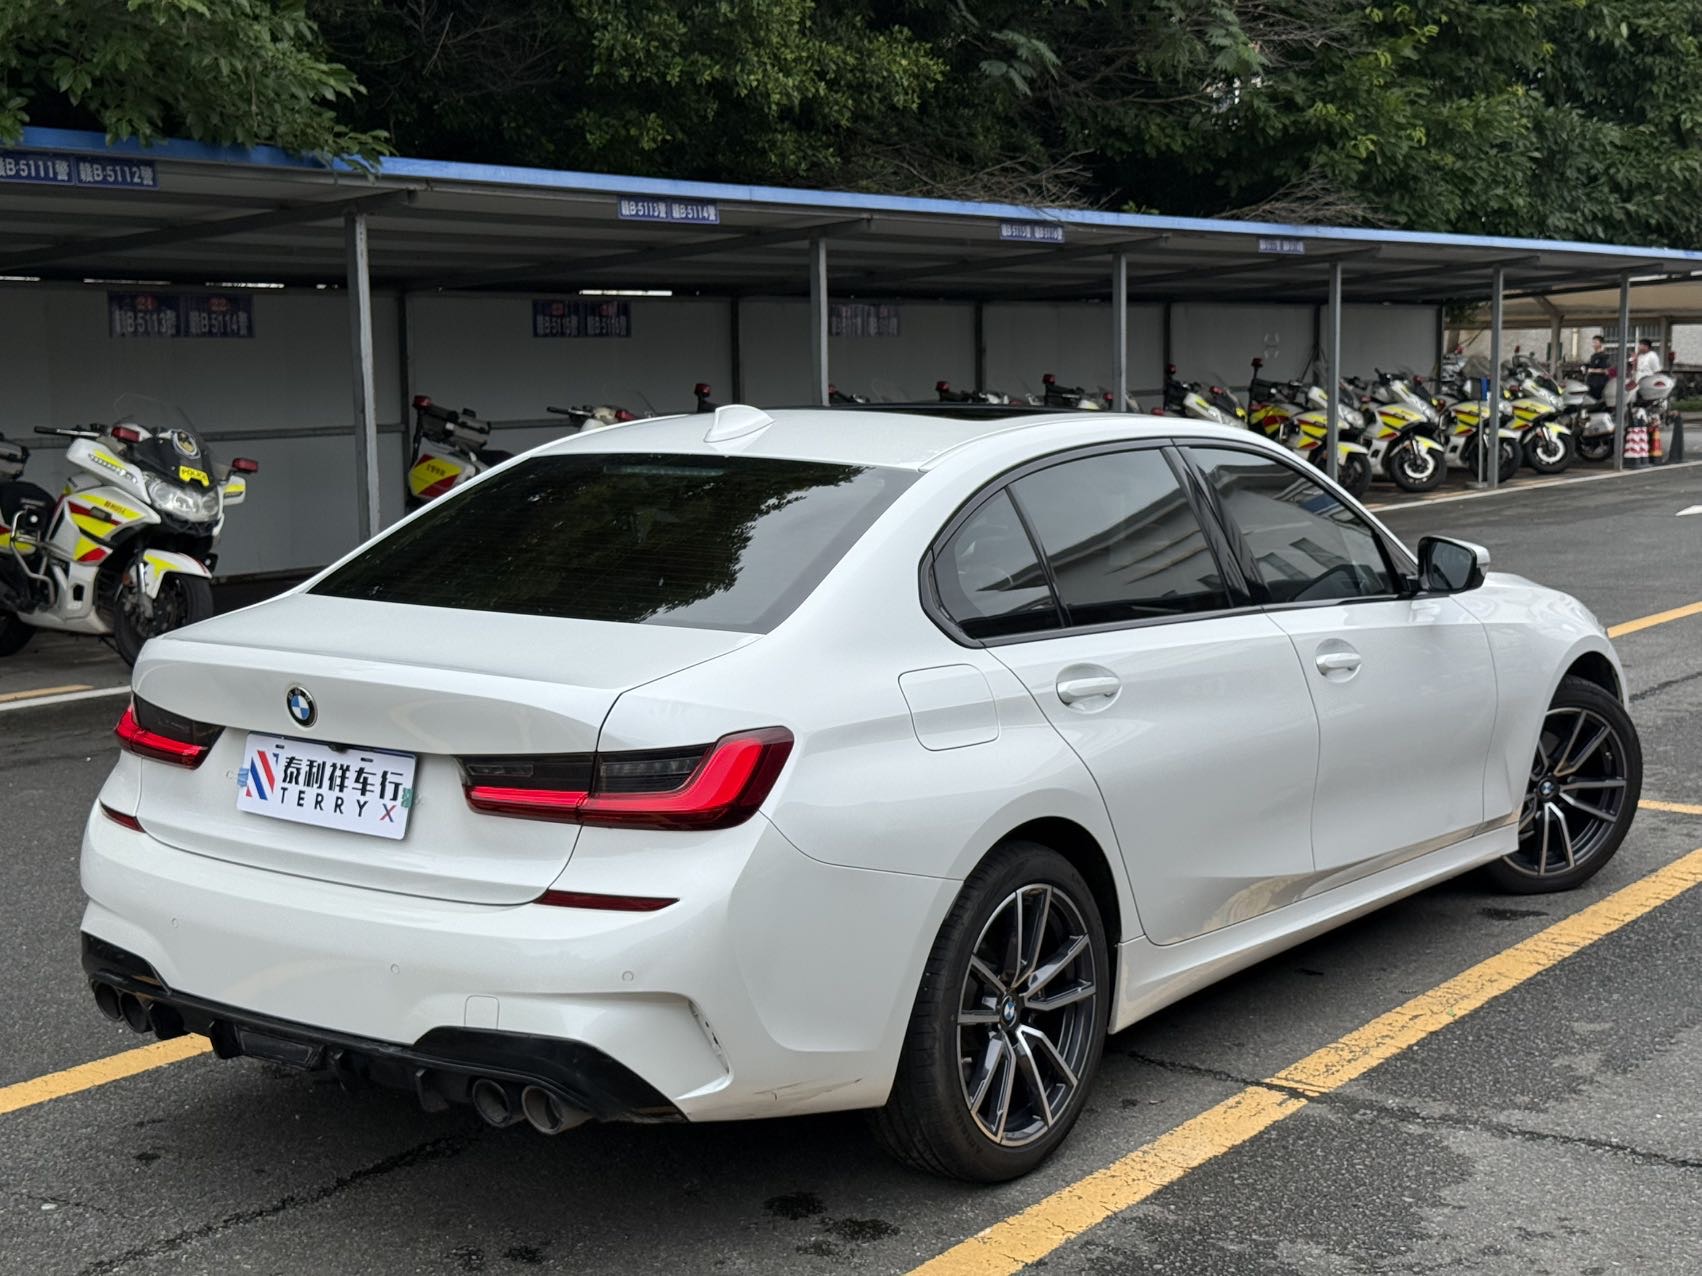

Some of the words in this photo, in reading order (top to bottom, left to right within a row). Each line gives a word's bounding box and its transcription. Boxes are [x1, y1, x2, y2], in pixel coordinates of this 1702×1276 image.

[280, 756, 404, 802] 泰利祥车行
